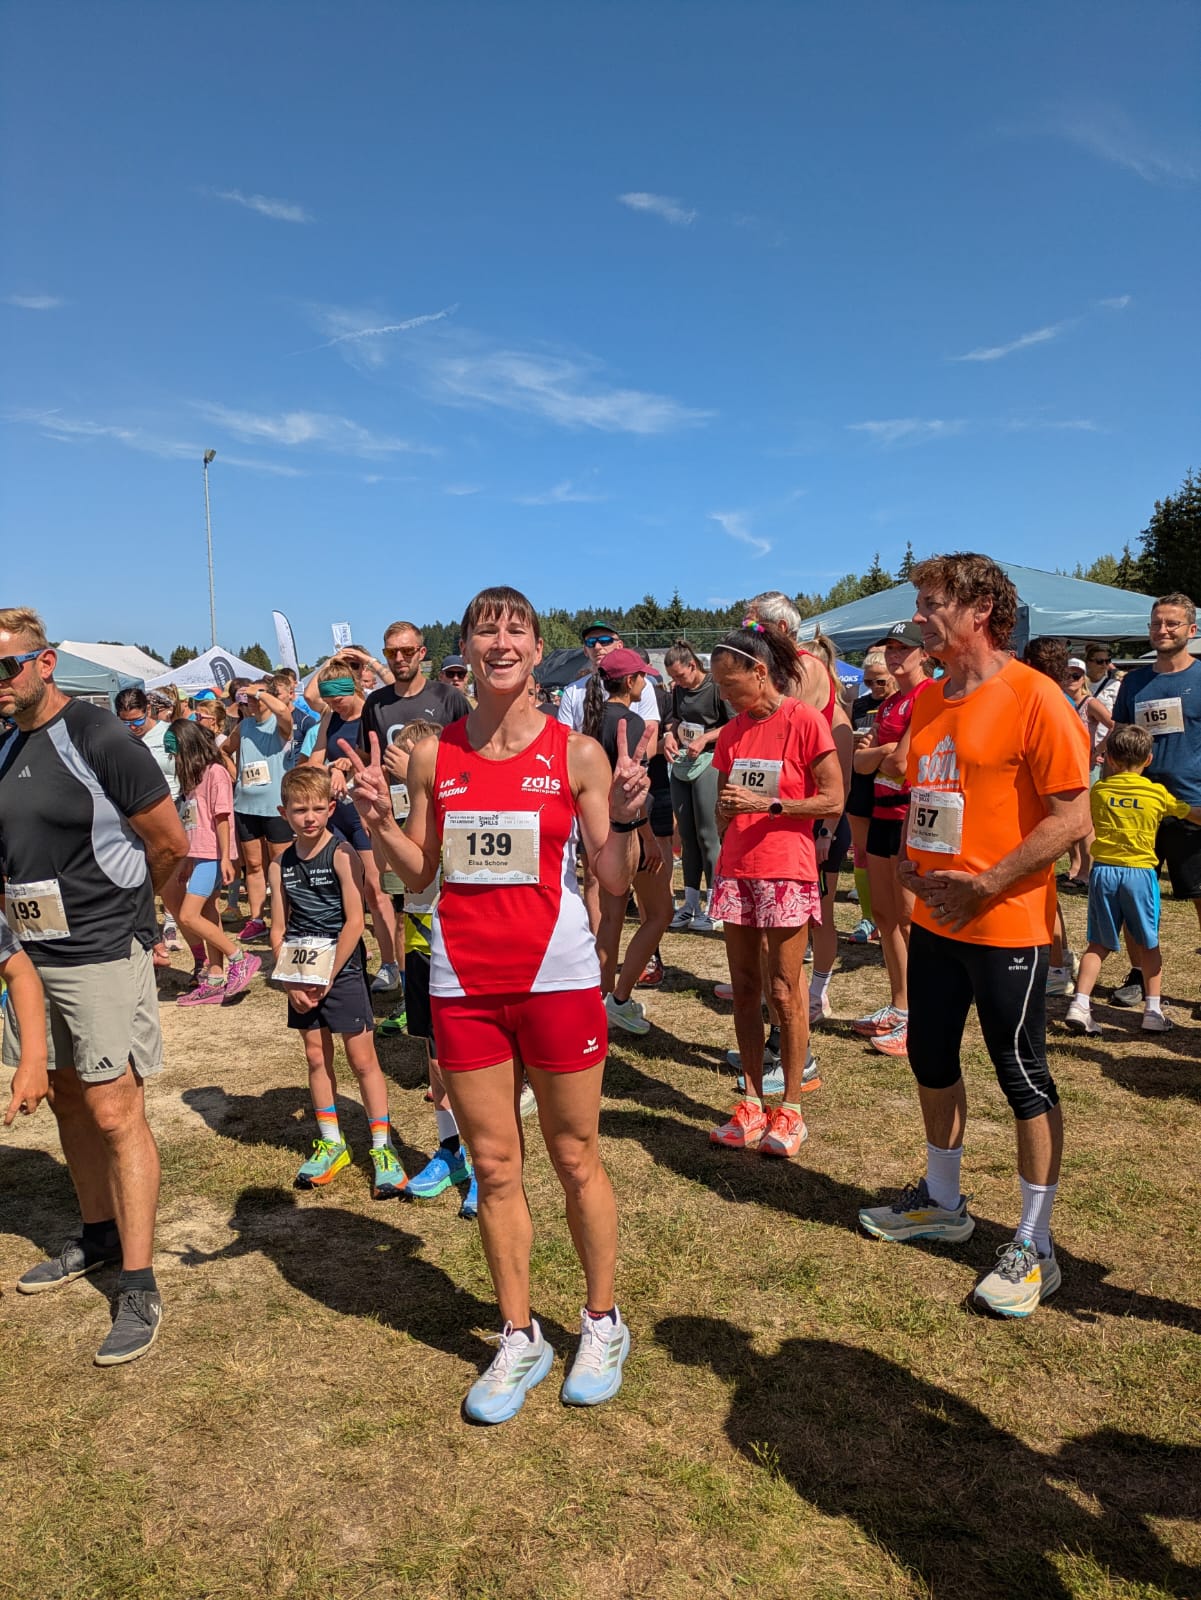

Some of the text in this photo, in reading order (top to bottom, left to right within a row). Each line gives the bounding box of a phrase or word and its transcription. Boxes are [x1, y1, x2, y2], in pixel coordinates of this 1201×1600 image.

[1143, 709, 1168, 723] 165
[246, 768, 261, 779] 114
[741, 771, 765, 787] 162
[440, 778, 456, 789] LAC
[1109, 797, 1144, 810] LCL
[913, 805, 939, 829] 57
[466, 832, 512, 856] 139
[11, 900, 41, 920] 193
[291, 949, 318, 966] 202
